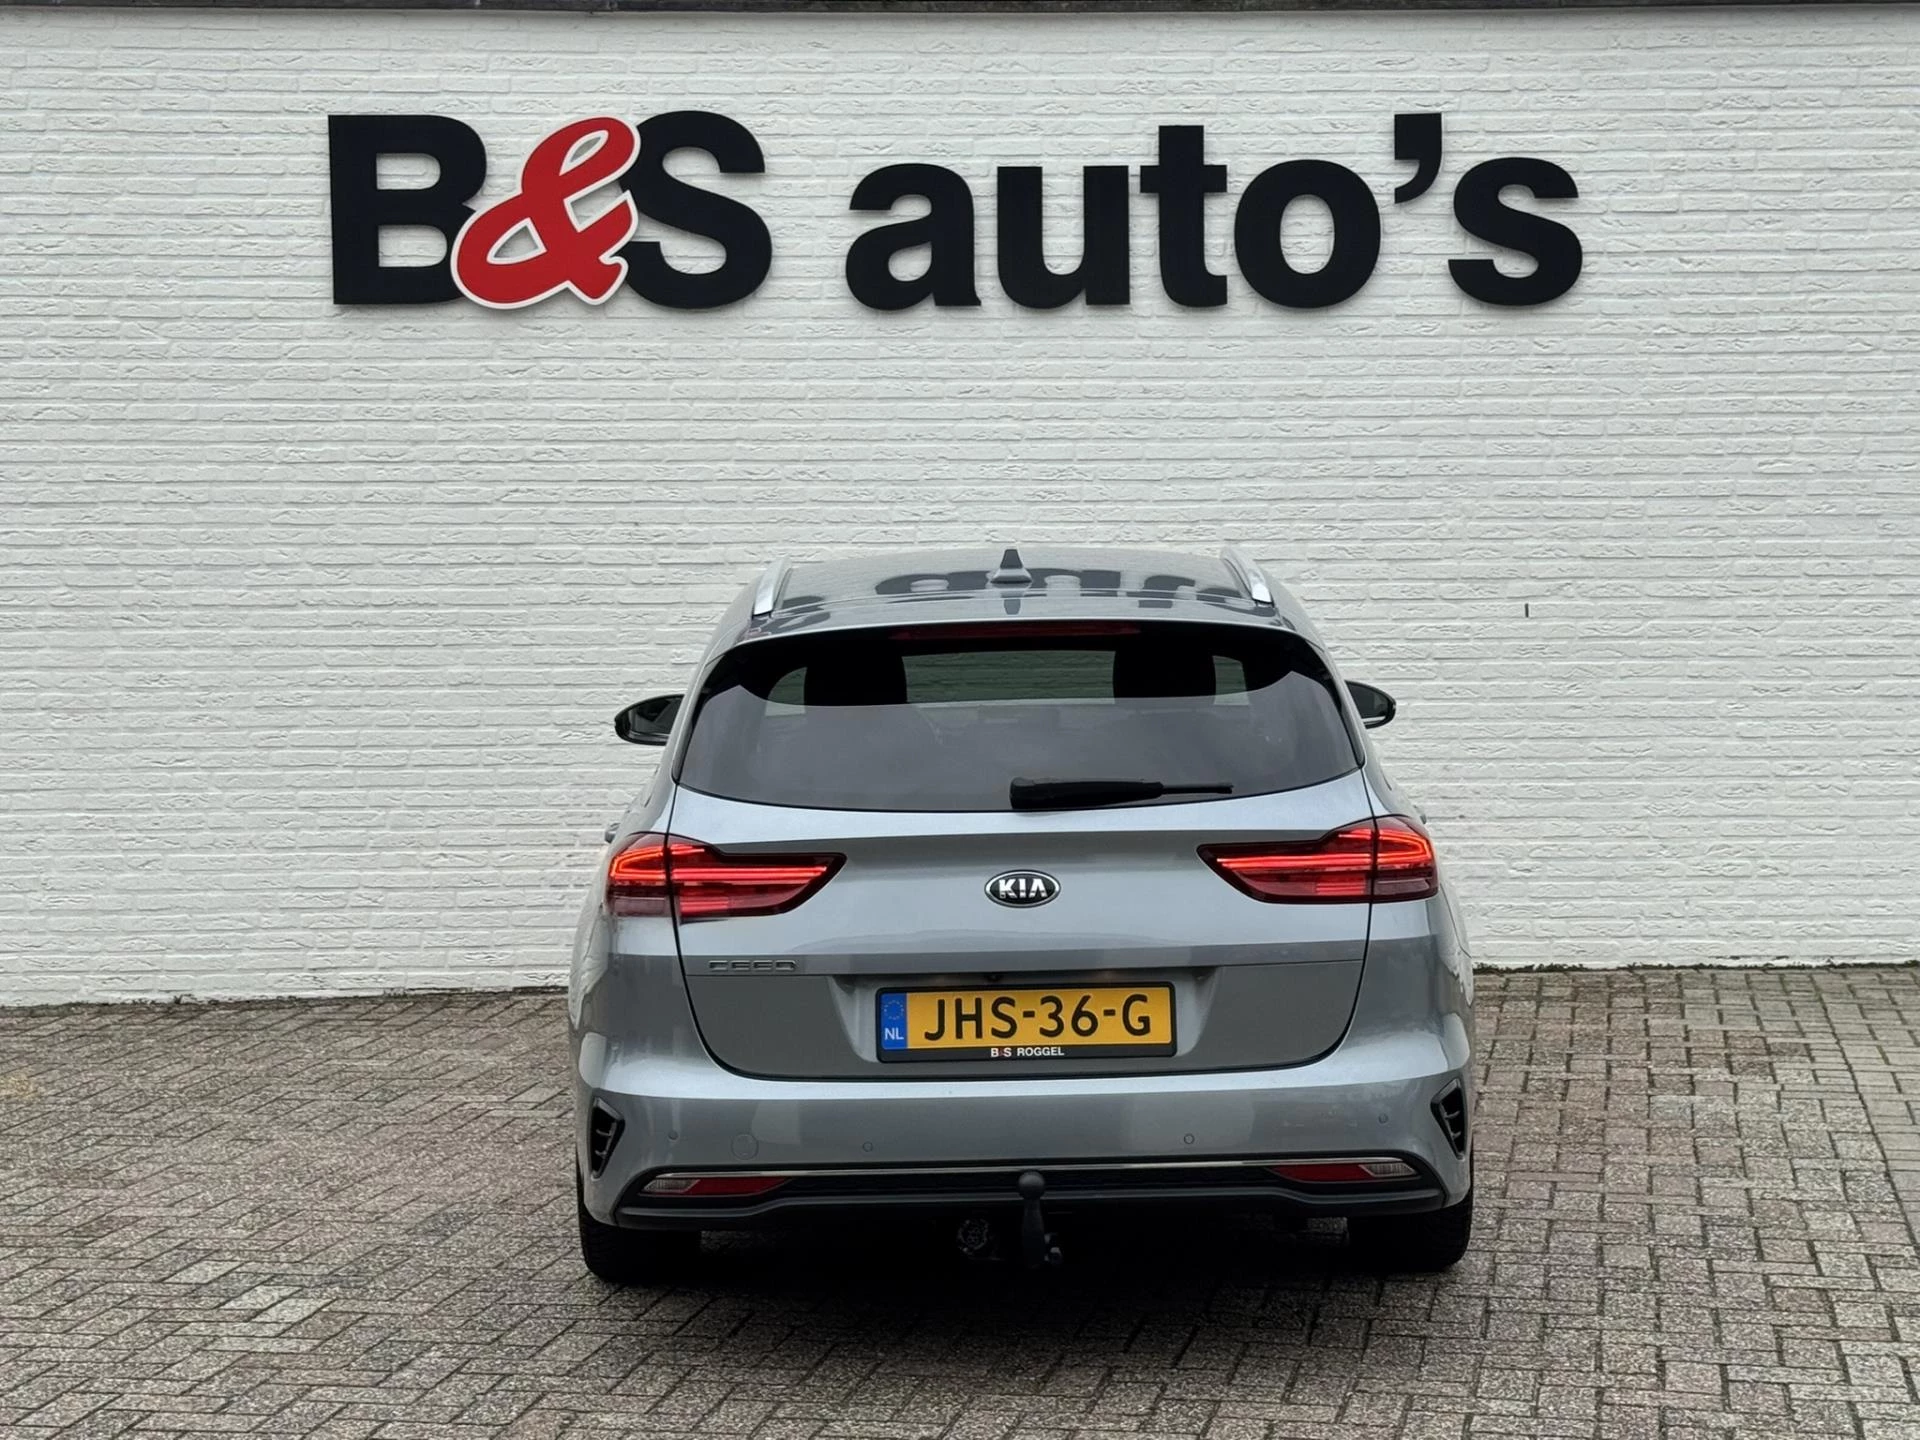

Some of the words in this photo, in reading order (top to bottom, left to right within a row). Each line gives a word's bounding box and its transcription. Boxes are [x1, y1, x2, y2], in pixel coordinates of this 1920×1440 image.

[328, 110, 772, 309] B&S
[845, 113, 1583, 310] auto's
[998, 878, 1048, 899] KIA
[708, 959, 797, 971] CEED
[924, 994, 1151, 1041] JHS-36-G
[884, 1027, 904, 1041] NL
[1016, 1046, 1065, 1057] ROGGEL
